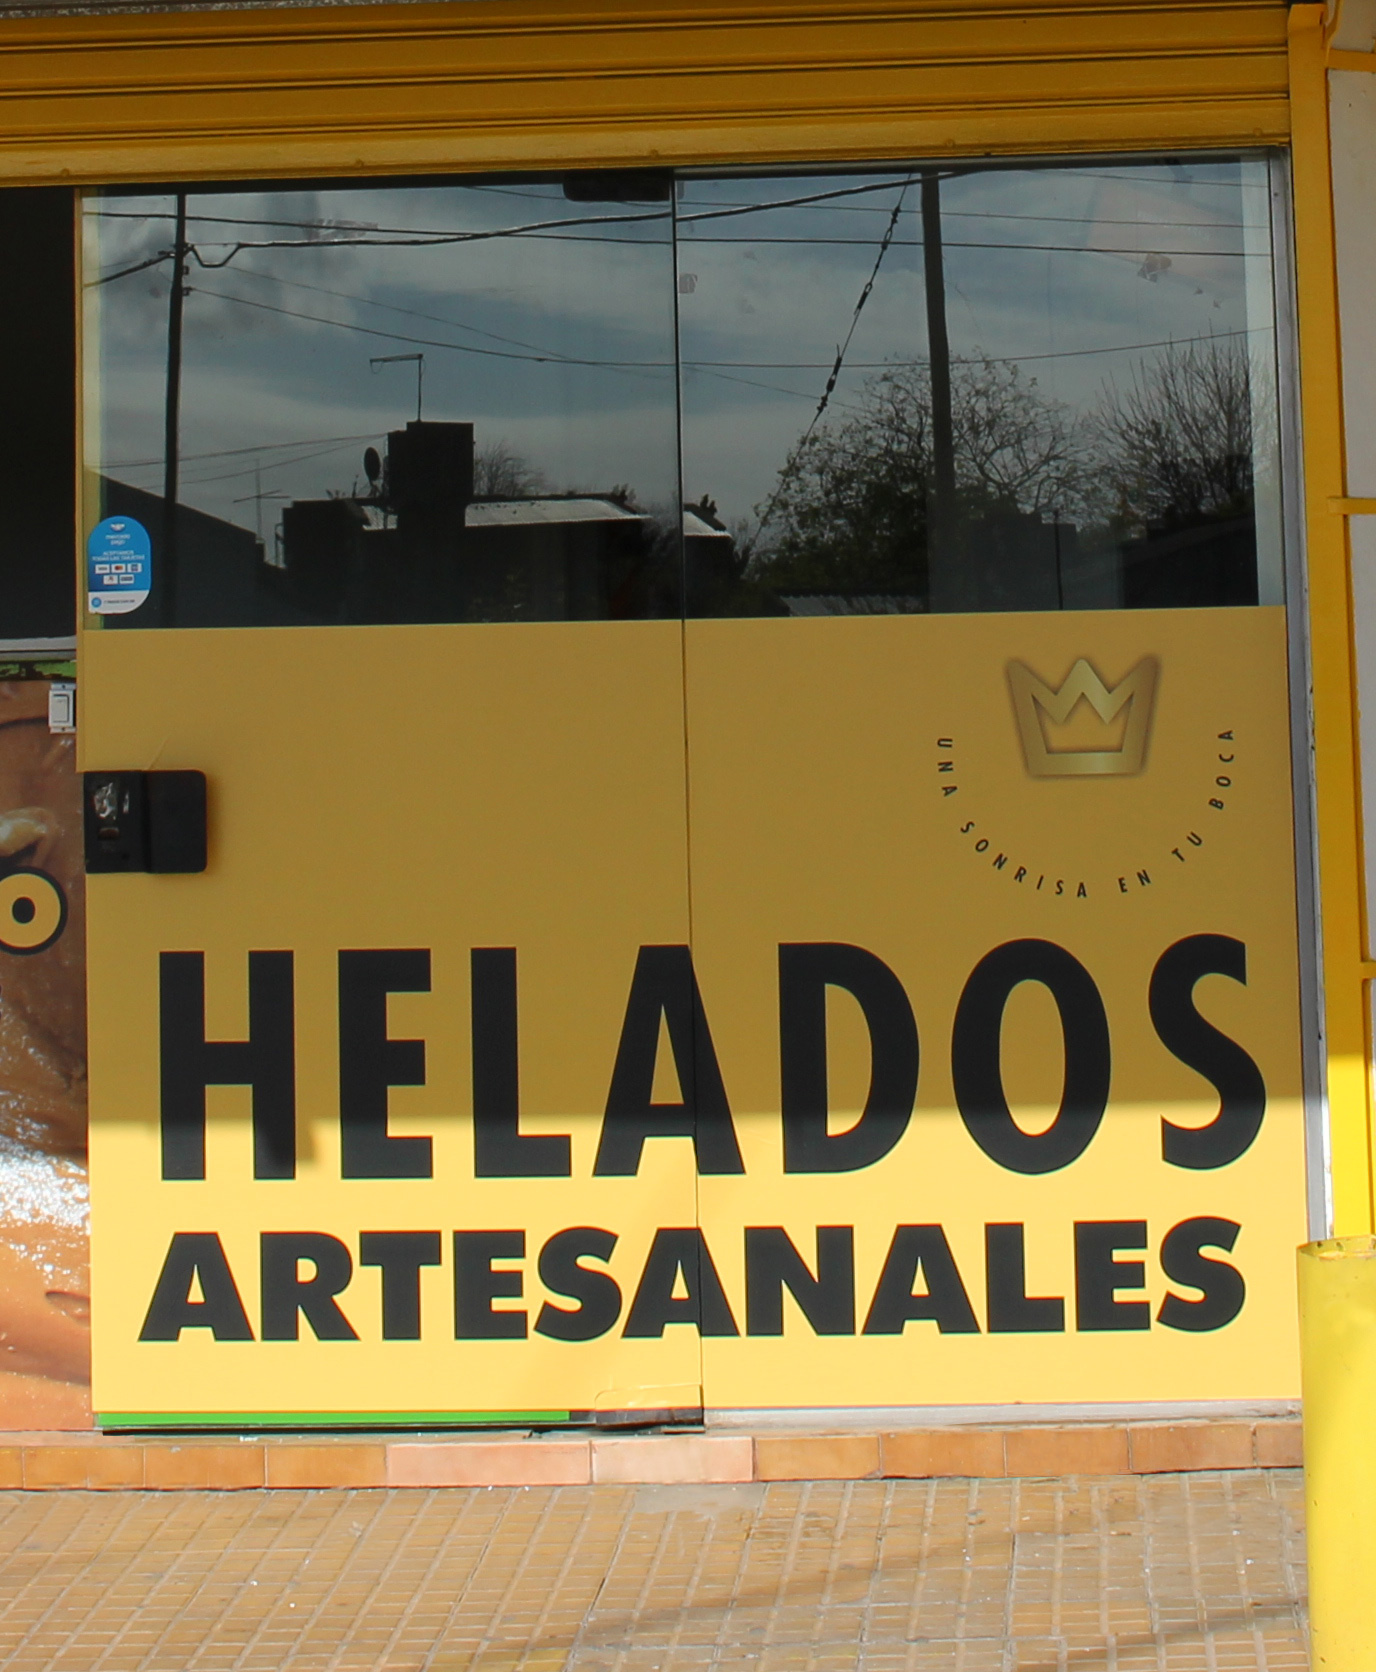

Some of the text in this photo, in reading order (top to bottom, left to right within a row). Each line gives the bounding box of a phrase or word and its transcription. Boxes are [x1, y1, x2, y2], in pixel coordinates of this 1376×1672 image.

[937, 729, 1235, 899] UNA SONRISA EN TU BOCA
[158, 931, 1267, 1182] HELADOS
[136, 1215, 1247, 1343] ARTESANALES
